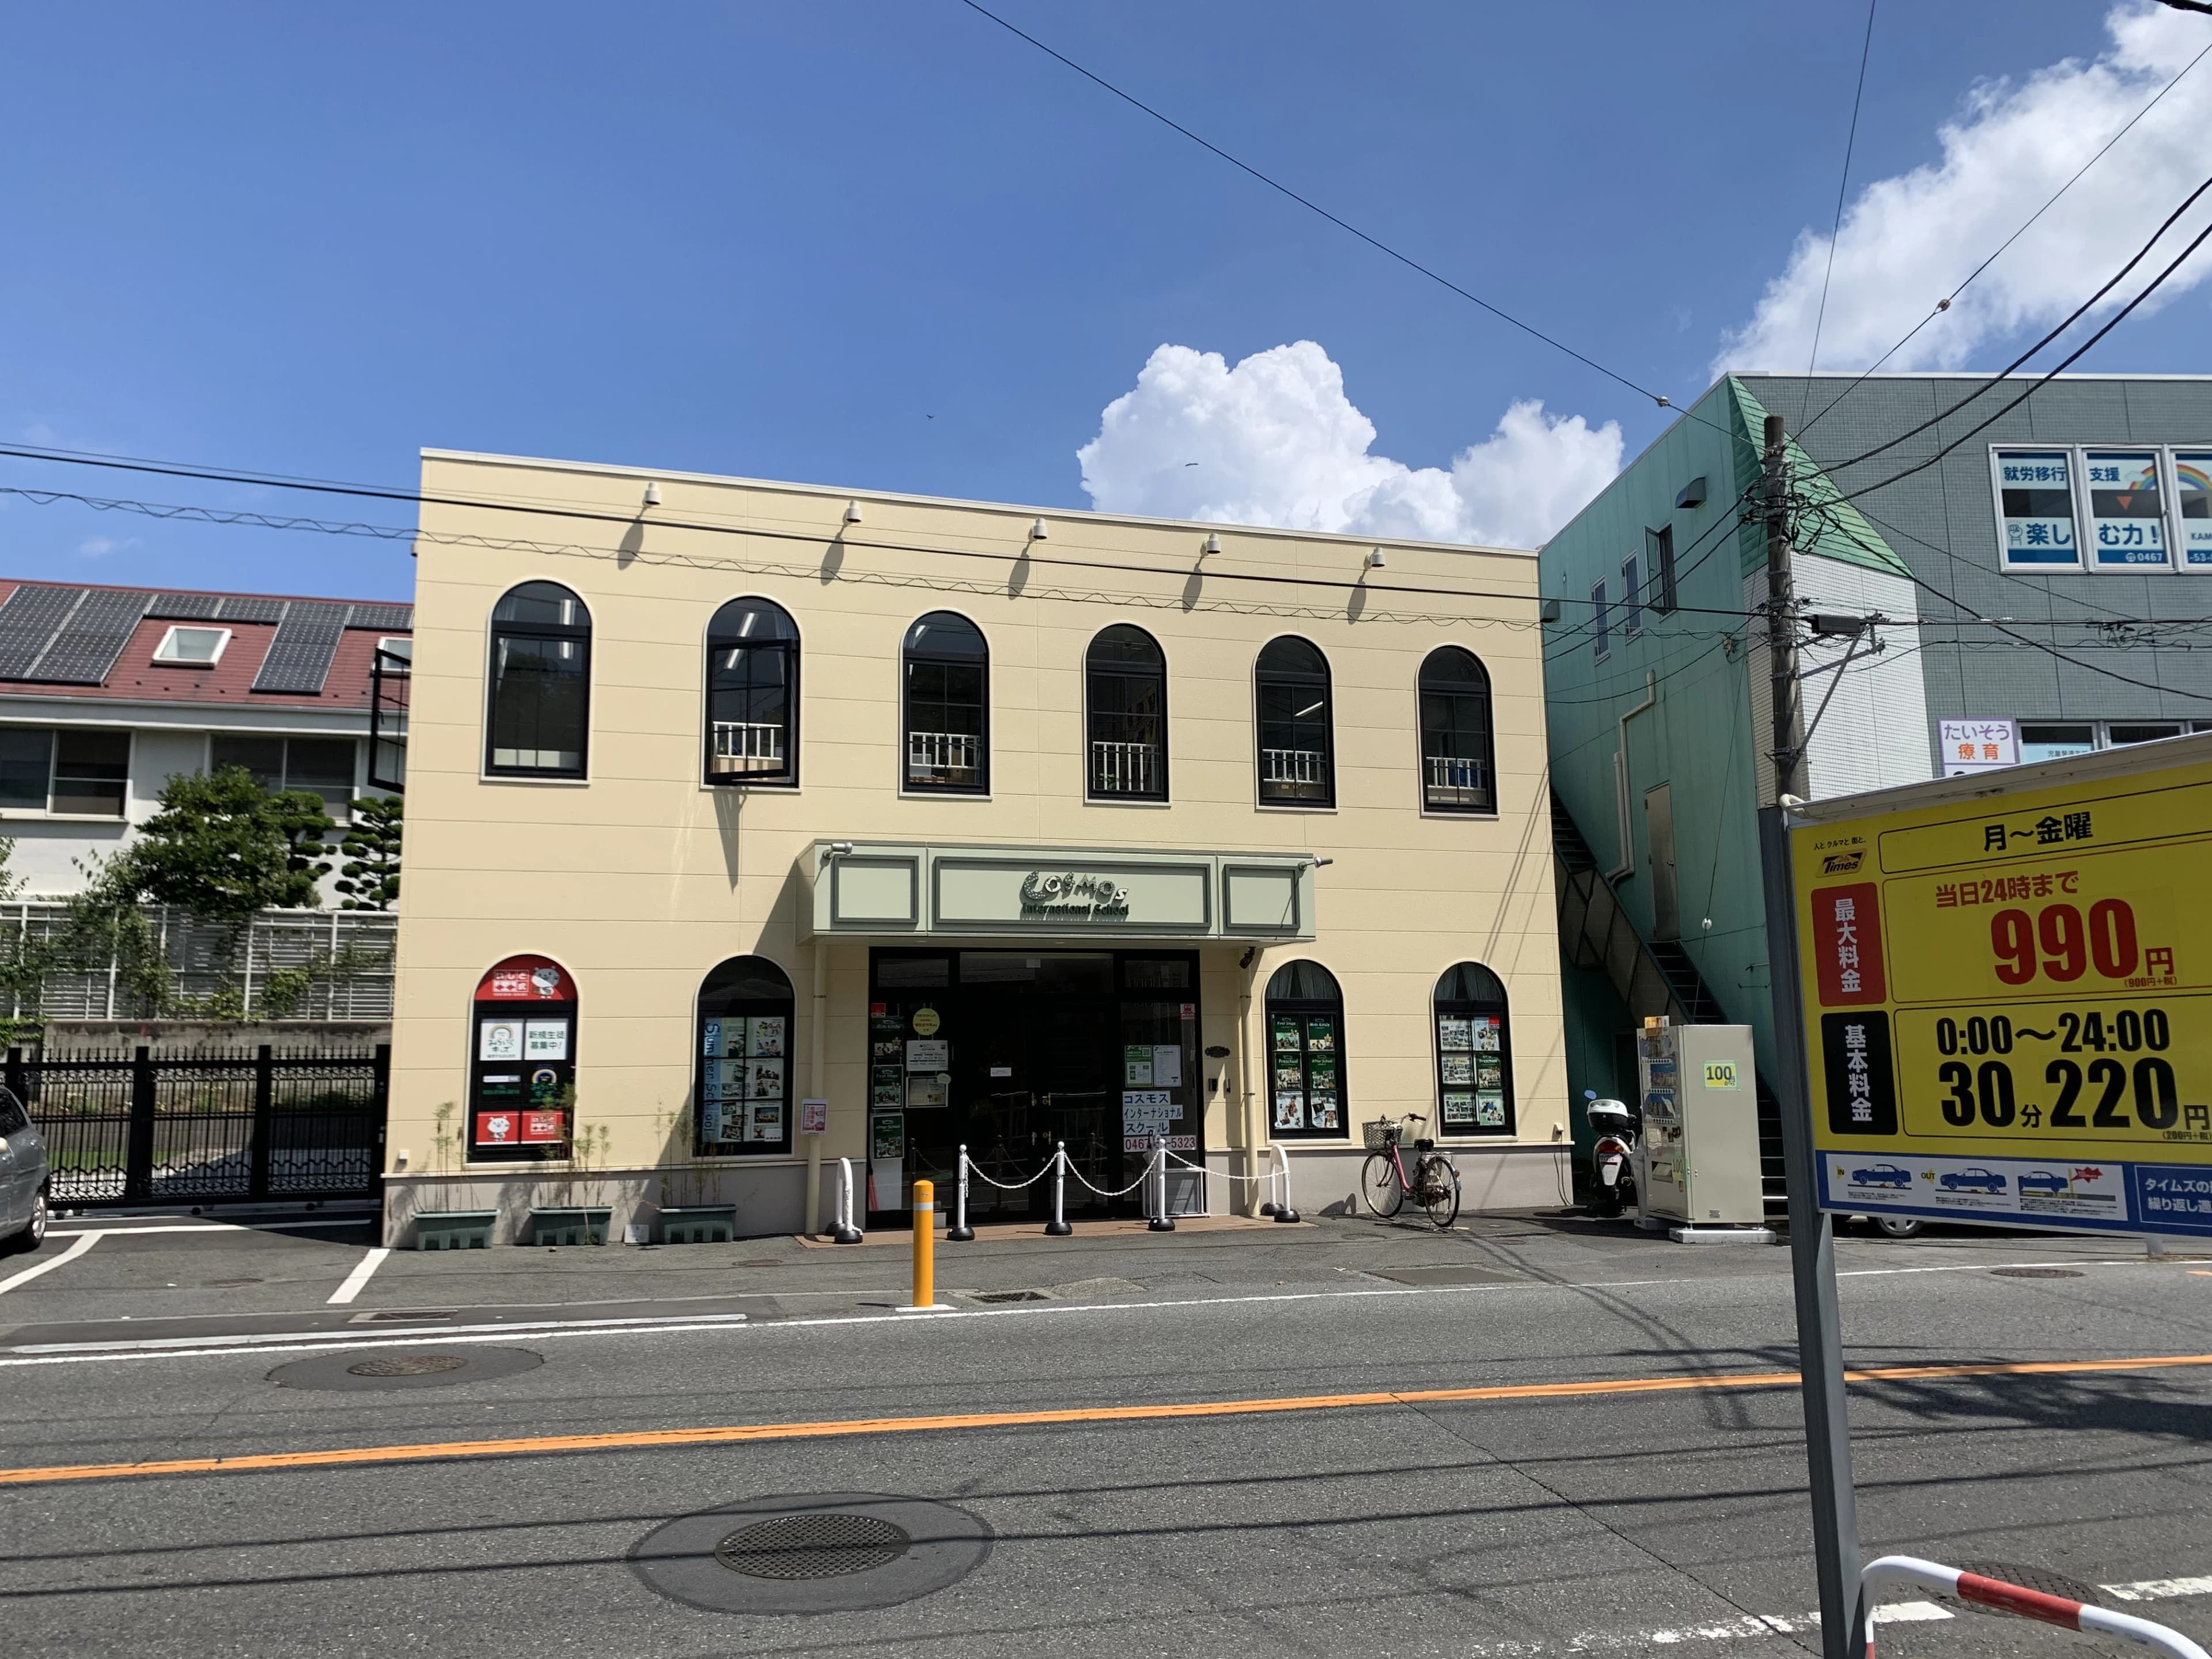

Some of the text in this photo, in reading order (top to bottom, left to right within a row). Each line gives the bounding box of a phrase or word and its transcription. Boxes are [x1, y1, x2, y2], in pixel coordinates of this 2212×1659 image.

[2003, 466, 2120, 482] 就労移行 支援
[2026, 522, 2071, 546] 楽し
[2137, 553, 2212, 562] 0467 -53-
[1944, 724, 2010, 741] たいそう
[1958, 743, 1999, 760] 療育
[1822, 852, 1863, 874] Times
[1936, 870, 2079, 908] 当日24時まで
[1022, 903, 1129, 915] International School
[1834, 897, 1862, 993] 最大料金
[1991, 898, 2175, 985] 990円
[1843, 1024, 1874, 1123] 基本料金
[1124, 1093, 1169, 1104] コスモス
[1124, 1106, 1182, 1120] インターナショナル
[1126, 1122, 1168, 1133] スクール
